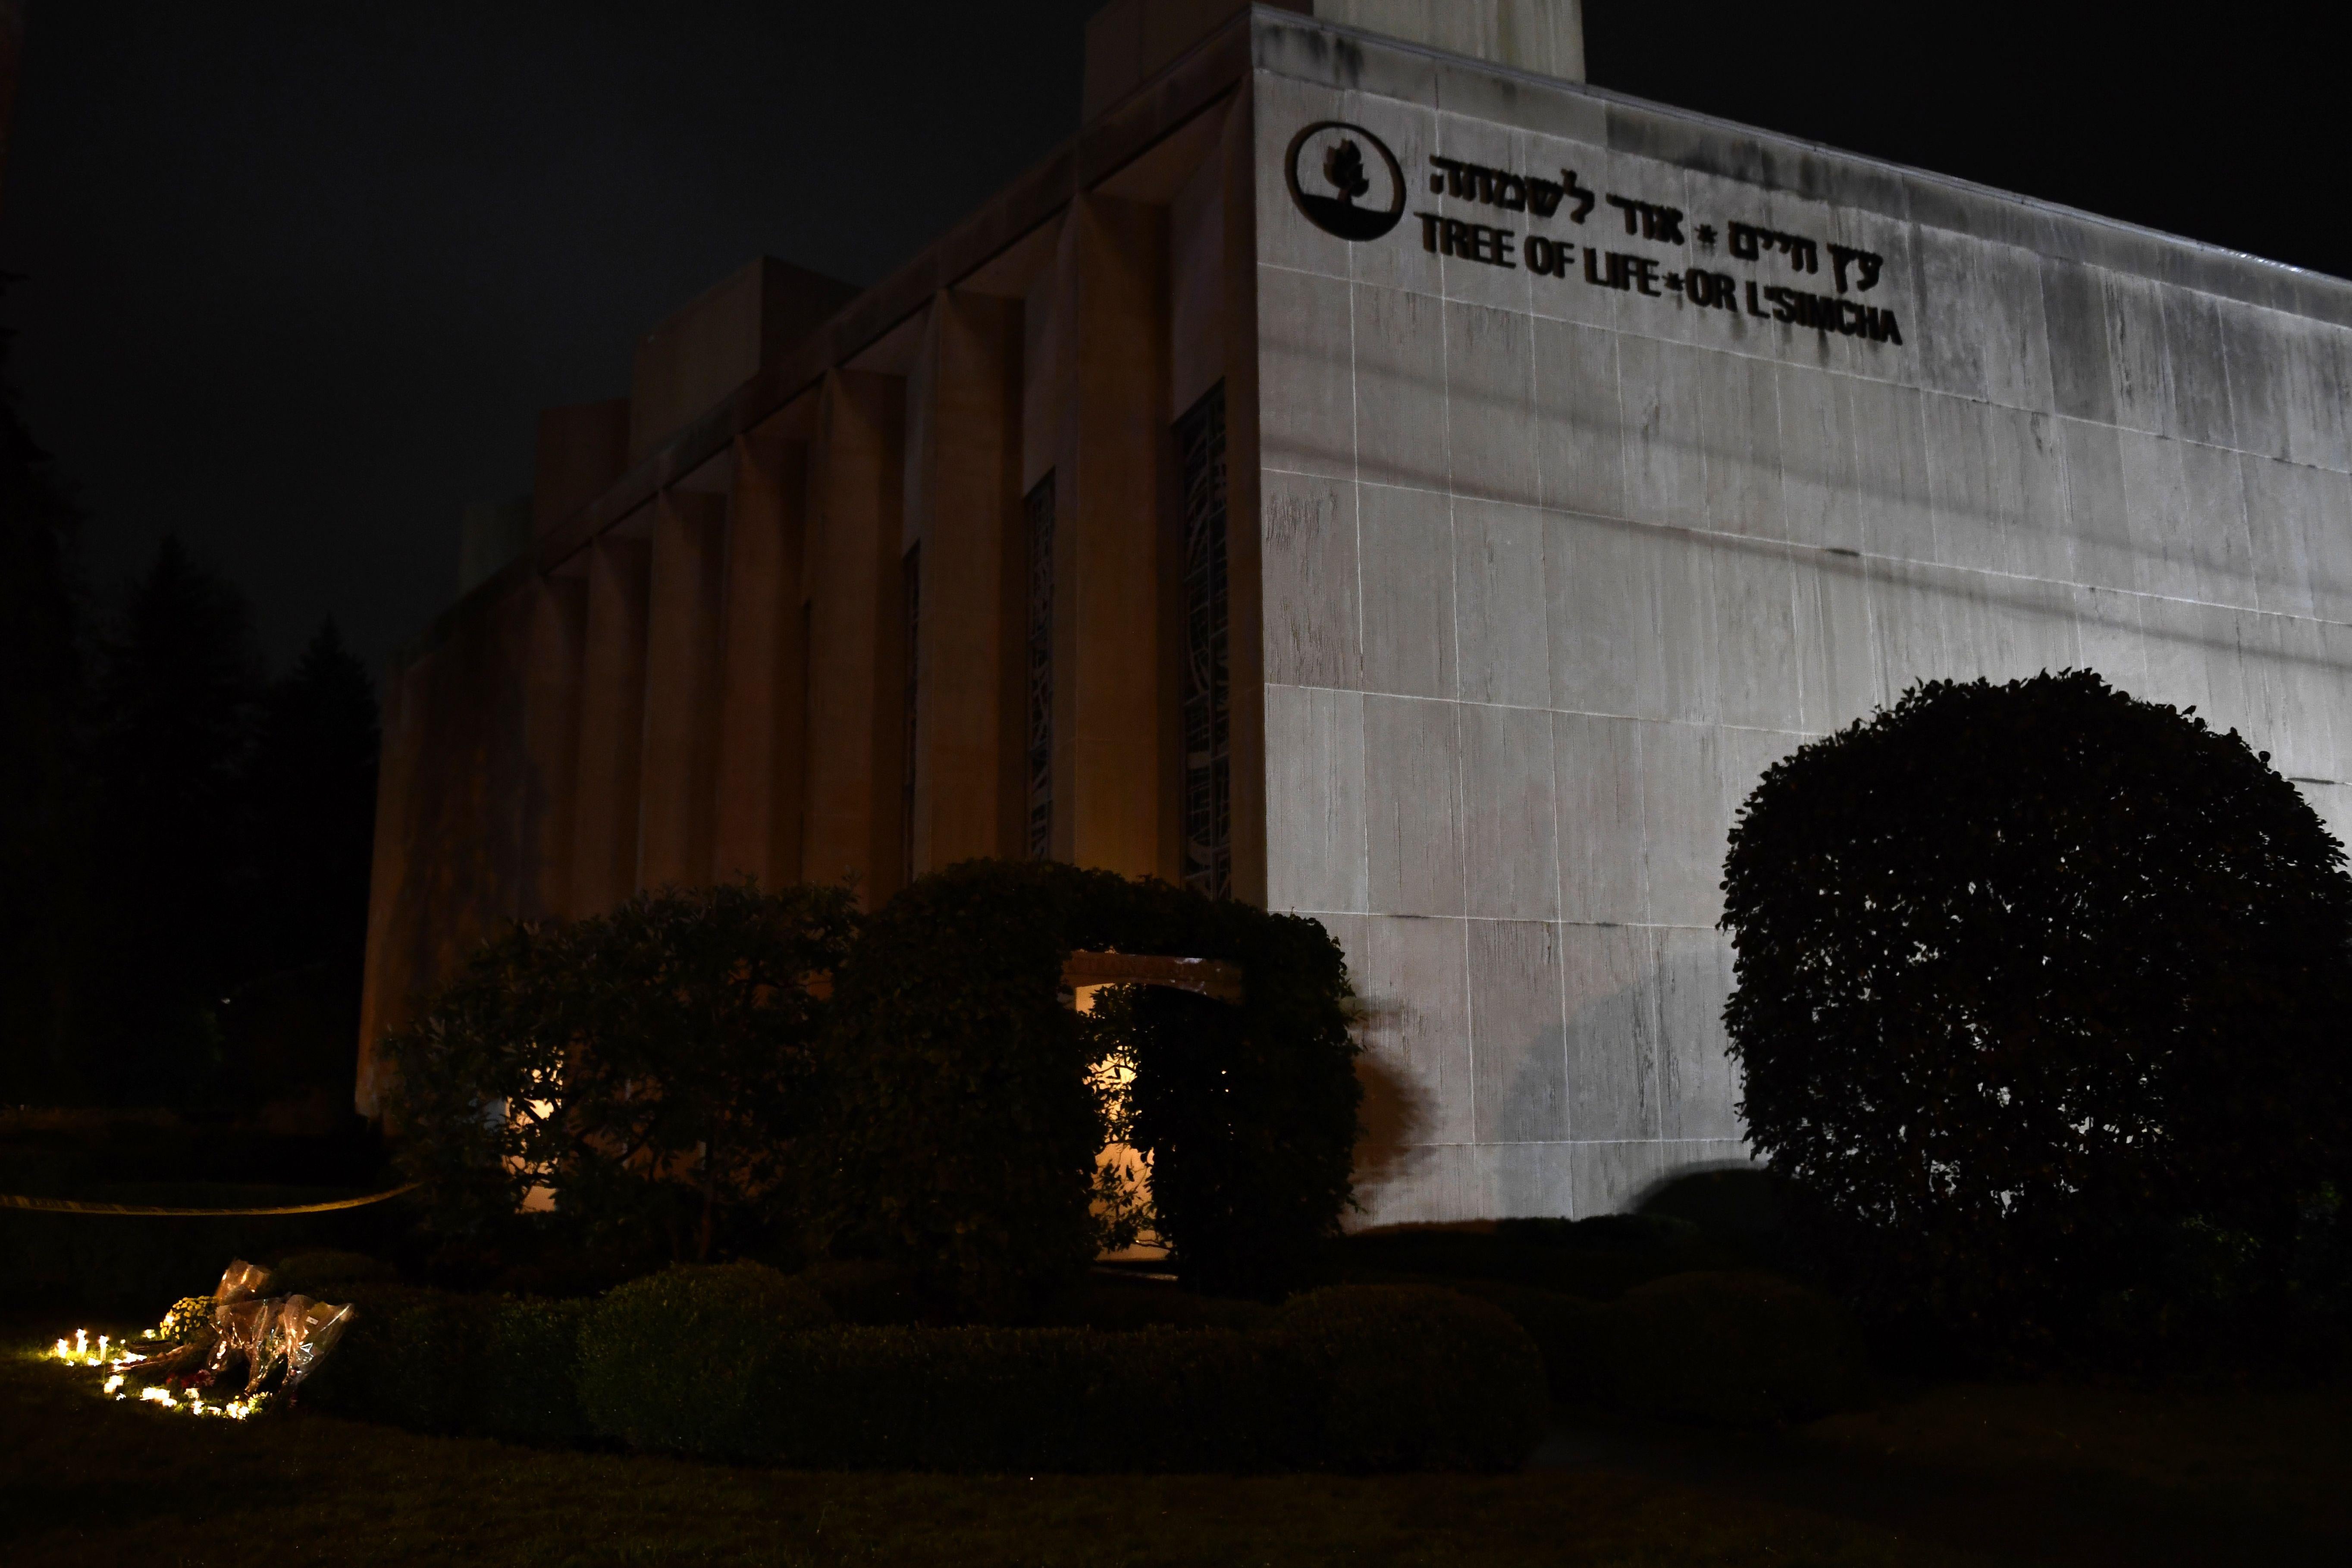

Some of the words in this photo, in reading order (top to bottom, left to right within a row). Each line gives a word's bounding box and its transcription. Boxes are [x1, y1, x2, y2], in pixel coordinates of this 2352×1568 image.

[1429, 154, 1596, 224] לשמחה
[1606, 193, 1684, 245] אור
[1728, 220, 1818, 275] חיים
[1827, 243, 1883, 294] עץ
[1414, 211, 1516, 269] TREE
[1524, 235, 1575, 279] OF
[1583, 247, 1662, 297] LIFE
[1685, 268, 1737, 312] OR
[1746, 281, 1903, 345] L'SIMCHA
